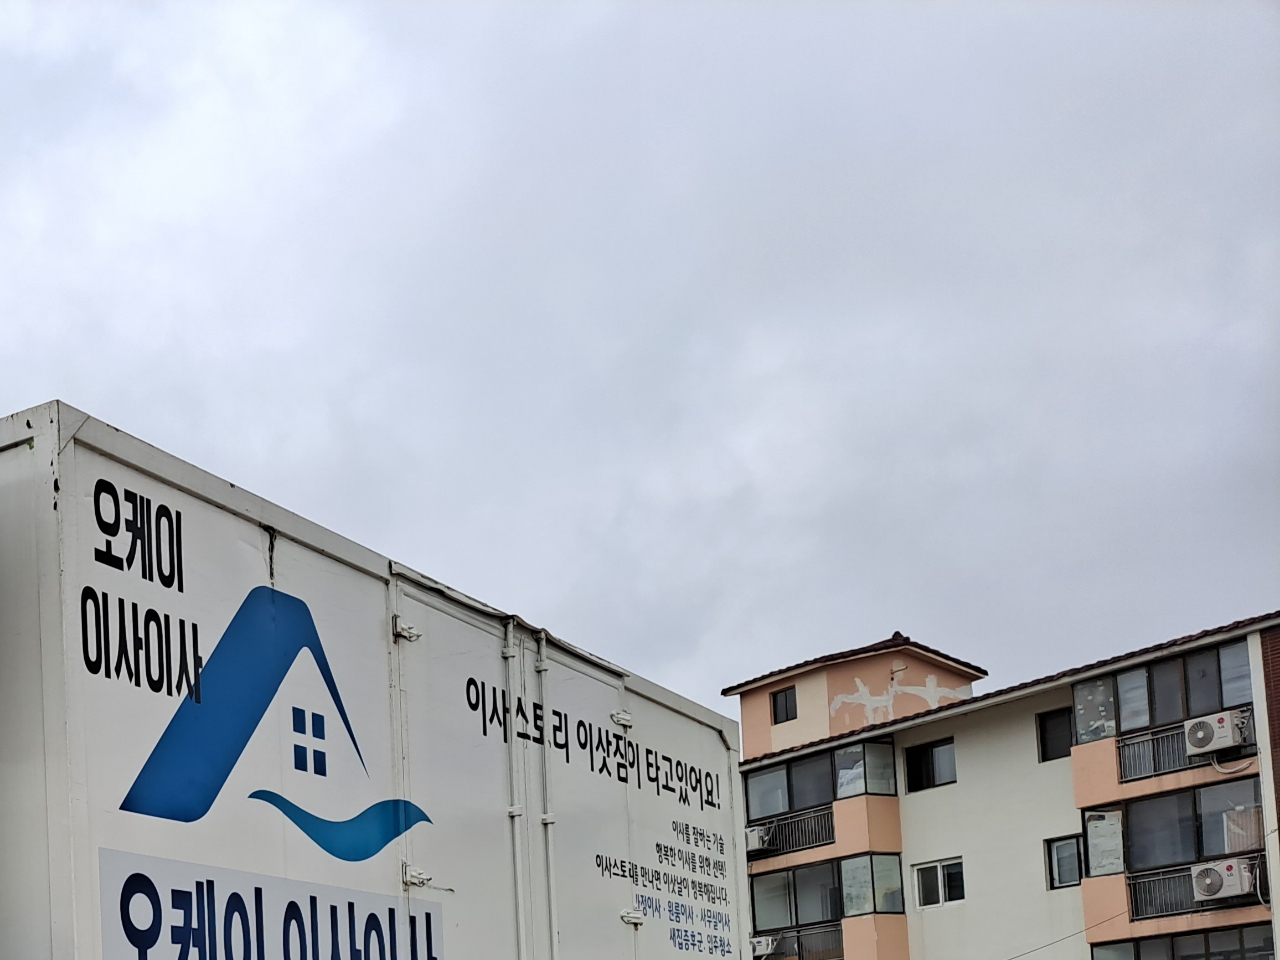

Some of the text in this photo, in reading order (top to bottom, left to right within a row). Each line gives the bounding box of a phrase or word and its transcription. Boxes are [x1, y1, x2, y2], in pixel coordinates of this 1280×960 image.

[93, 478, 184, 592] 오케이
[81, 586, 203, 704] 이사이사
[465, 677, 570, 764] 이사스토리
[577, 719, 641, 790] 이삿짐이
[656, 841, 676, 867] 행복한
[677, 849, 697, 873] 이사를
[698, 855, 711, 876] 위한
[672, 820, 725, 855] 이사를 잘하는 기술
[595, 854, 638, 886] 이사스토리를
[640, 866, 662, 892] 만나면
[663, 872, 690, 898] 이삿날이
[668, 900, 694, 925] 원룸이사
[701, 907, 731, 932] 사무실이사
